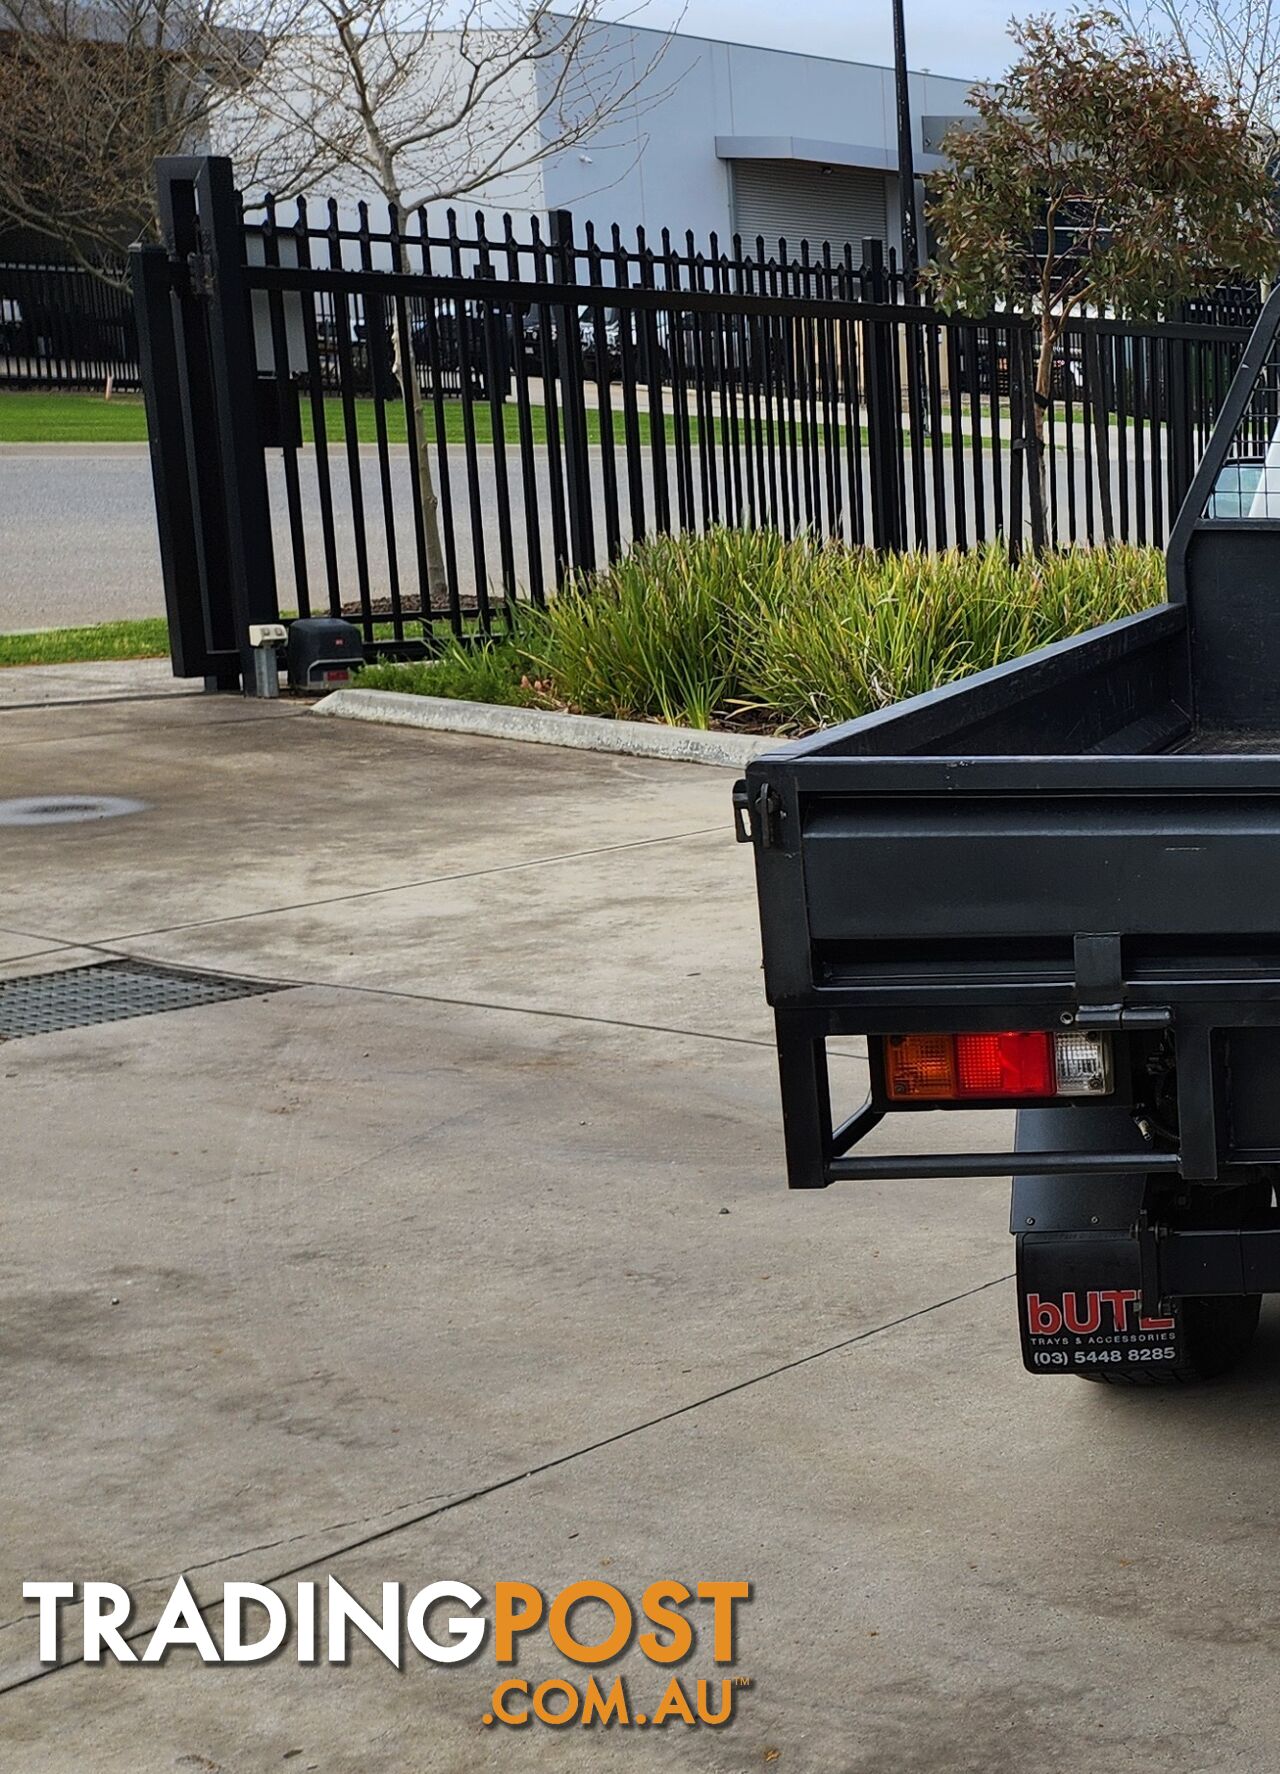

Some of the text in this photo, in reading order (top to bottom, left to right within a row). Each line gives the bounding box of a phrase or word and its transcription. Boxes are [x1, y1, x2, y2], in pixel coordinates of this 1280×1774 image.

[1031, 1337, 1069, 1346] TRAYS
[1088, 1332, 1177, 1345] ACCESSORIES
[1034, 1346, 1176, 1366] (03) 5448 8285
